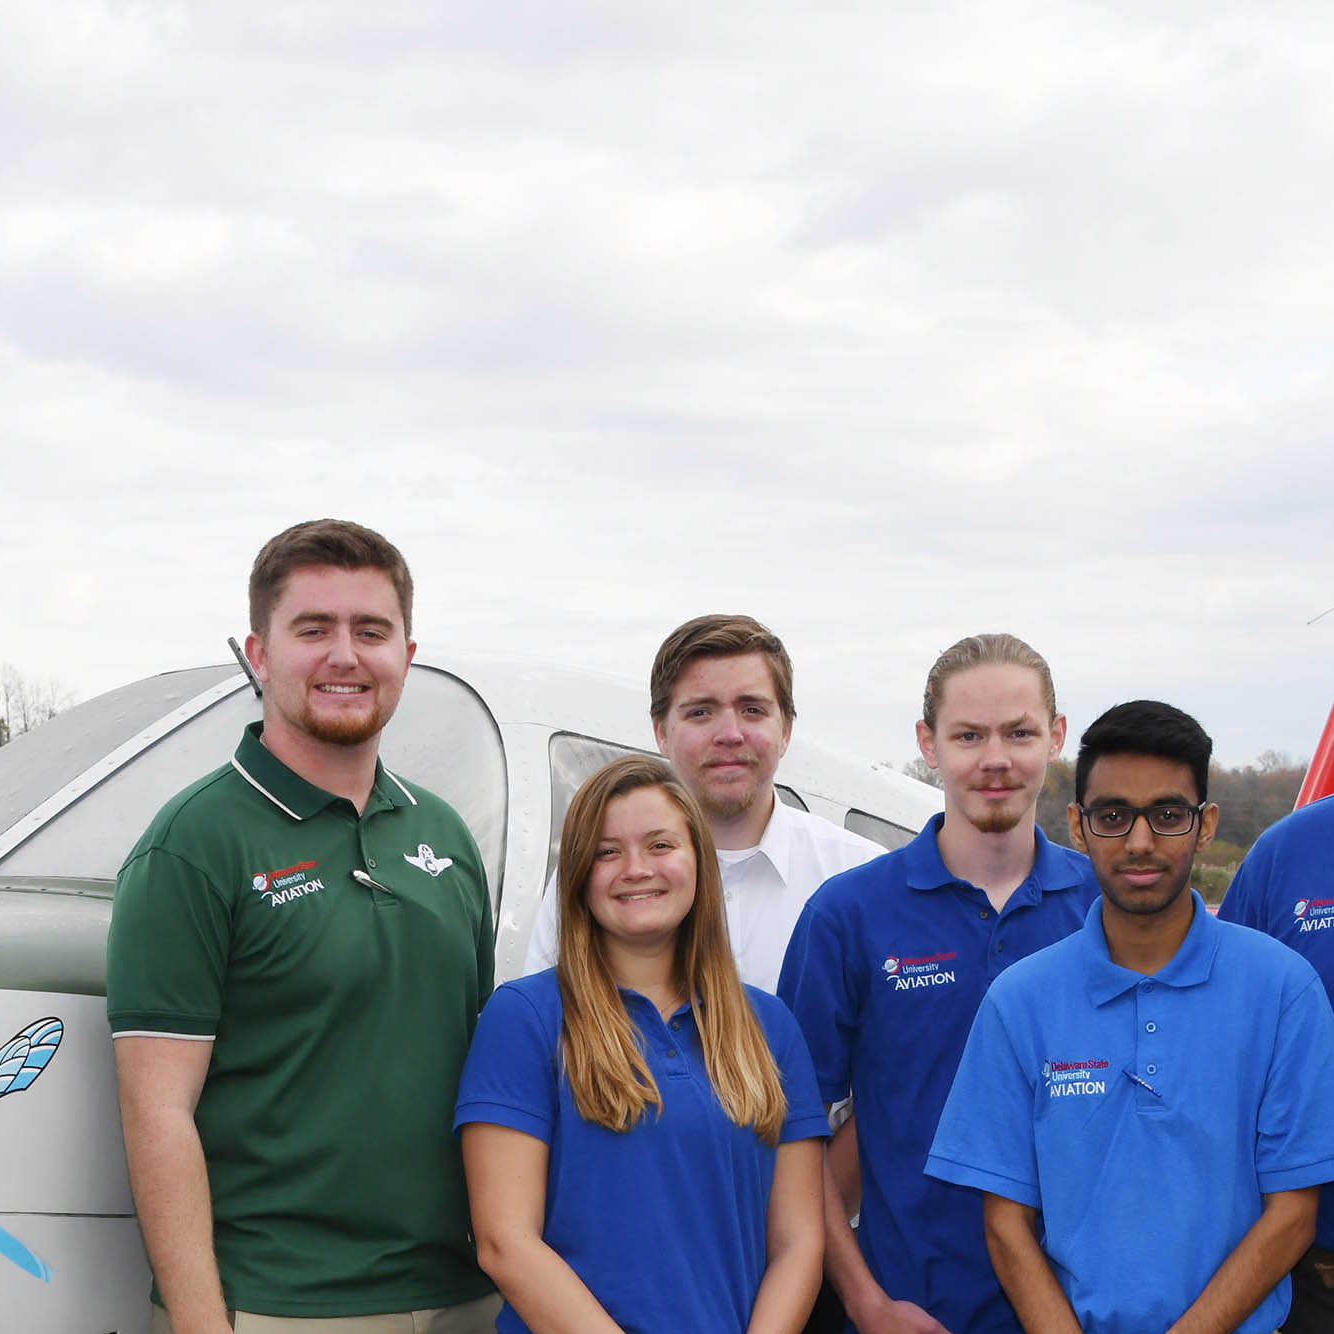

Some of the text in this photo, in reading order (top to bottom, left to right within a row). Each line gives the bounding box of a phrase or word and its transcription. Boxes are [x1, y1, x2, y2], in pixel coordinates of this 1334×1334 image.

[273, 872, 307, 889] University
[271, 878, 325, 907] AVIATION
[902, 962, 939, 974] University
[894, 970, 956, 991] AVIATION
[1051, 1069, 1091, 1081] University
[1050, 1081, 1106, 1098] AVIATION
